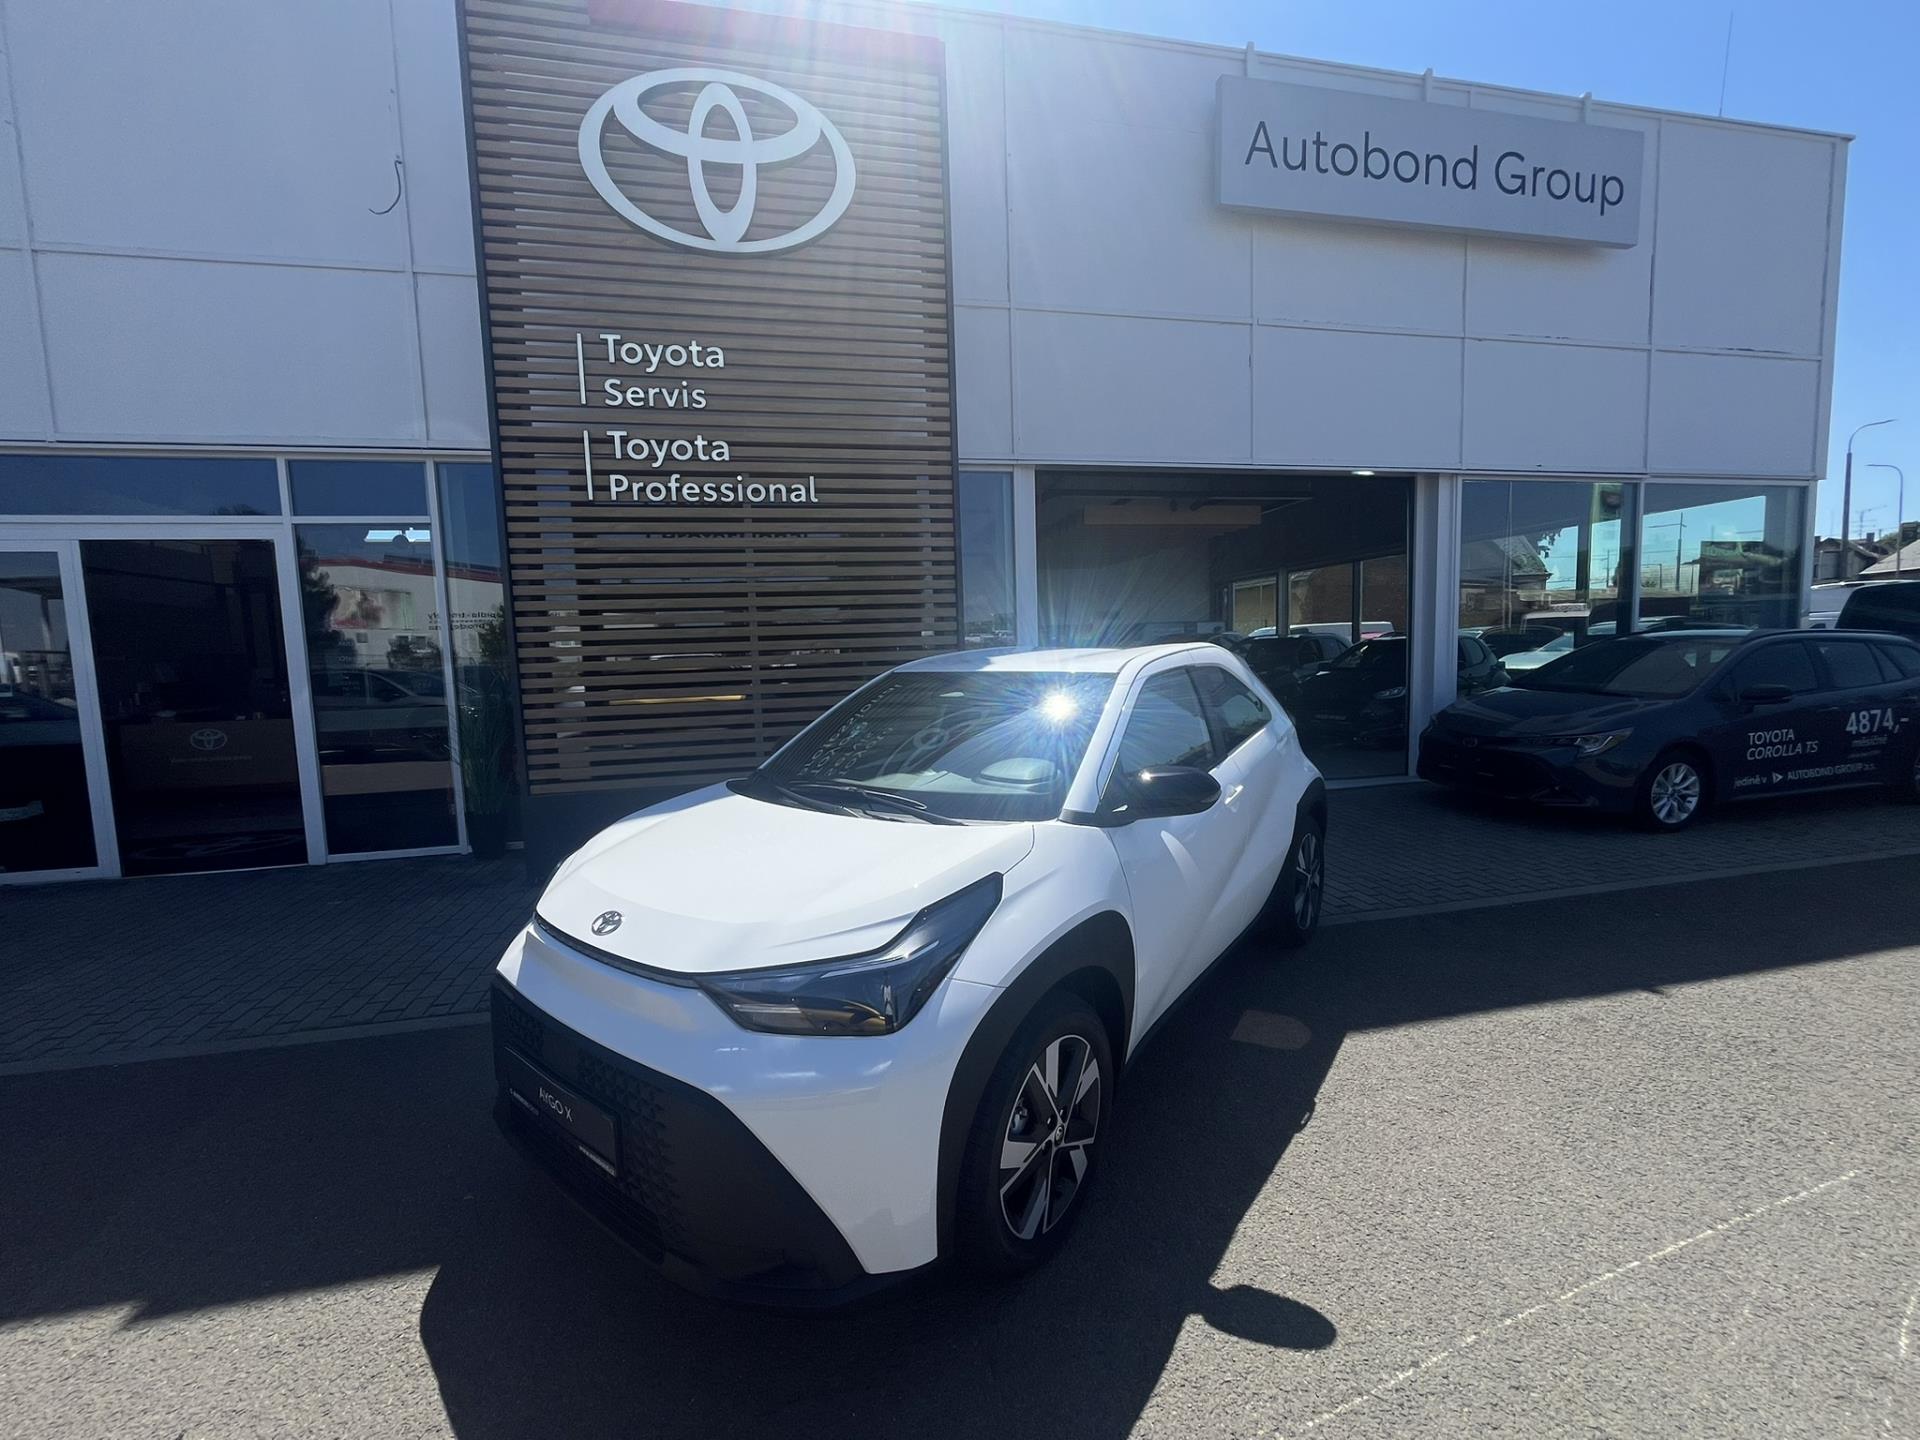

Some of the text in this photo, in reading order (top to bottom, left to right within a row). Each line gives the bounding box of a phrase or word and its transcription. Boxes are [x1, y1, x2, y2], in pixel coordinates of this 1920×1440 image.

[1244, 120, 1625, 216] Autobond Group
[599, 333, 726, 374] Toyota
[603, 378, 708, 409] Servis
[606, 430, 731, 468] Toyota
[608, 473, 819, 504] Professional
[1845, 707, 1910, 735] 4874,-
[1746, 740, 1819, 761] COROLLA TS
[1747, 728, 1796, 746] TOYOTA
[1787, 766, 1834, 781] AUTOBOND
[1834, 762, 1863, 775] GROUP
[564, 1105, 573, 1122] X
